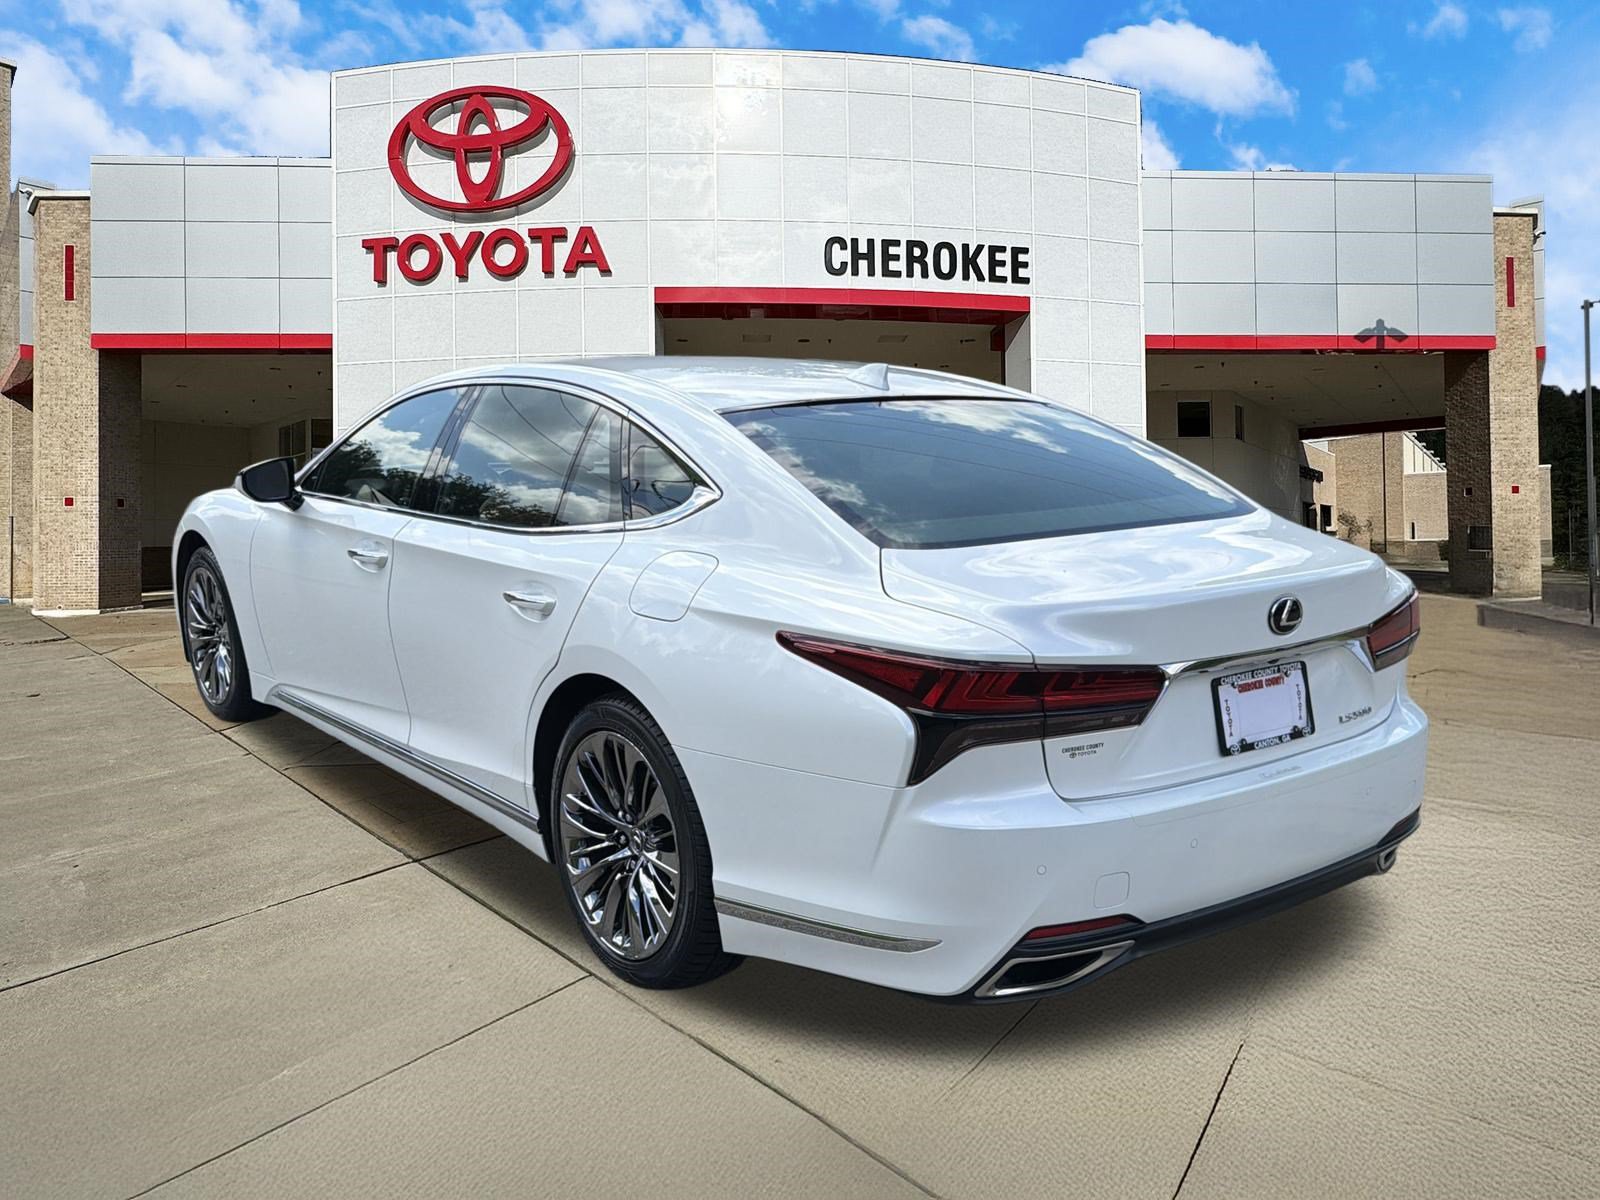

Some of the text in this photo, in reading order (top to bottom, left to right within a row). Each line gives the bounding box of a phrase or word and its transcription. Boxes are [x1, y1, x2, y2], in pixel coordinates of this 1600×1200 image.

[362, 226, 611, 285] TOYOTA
[824, 236, 1031, 284] CHEROKEE
[1220, 662, 1302, 685] CHEROKEE COUNTY TOYOTA
[1224, 698, 1234, 737] TOYOTA
[1062, 745, 1085, 753] CHEROKEE
[1281, 733, 1292, 744] GA
